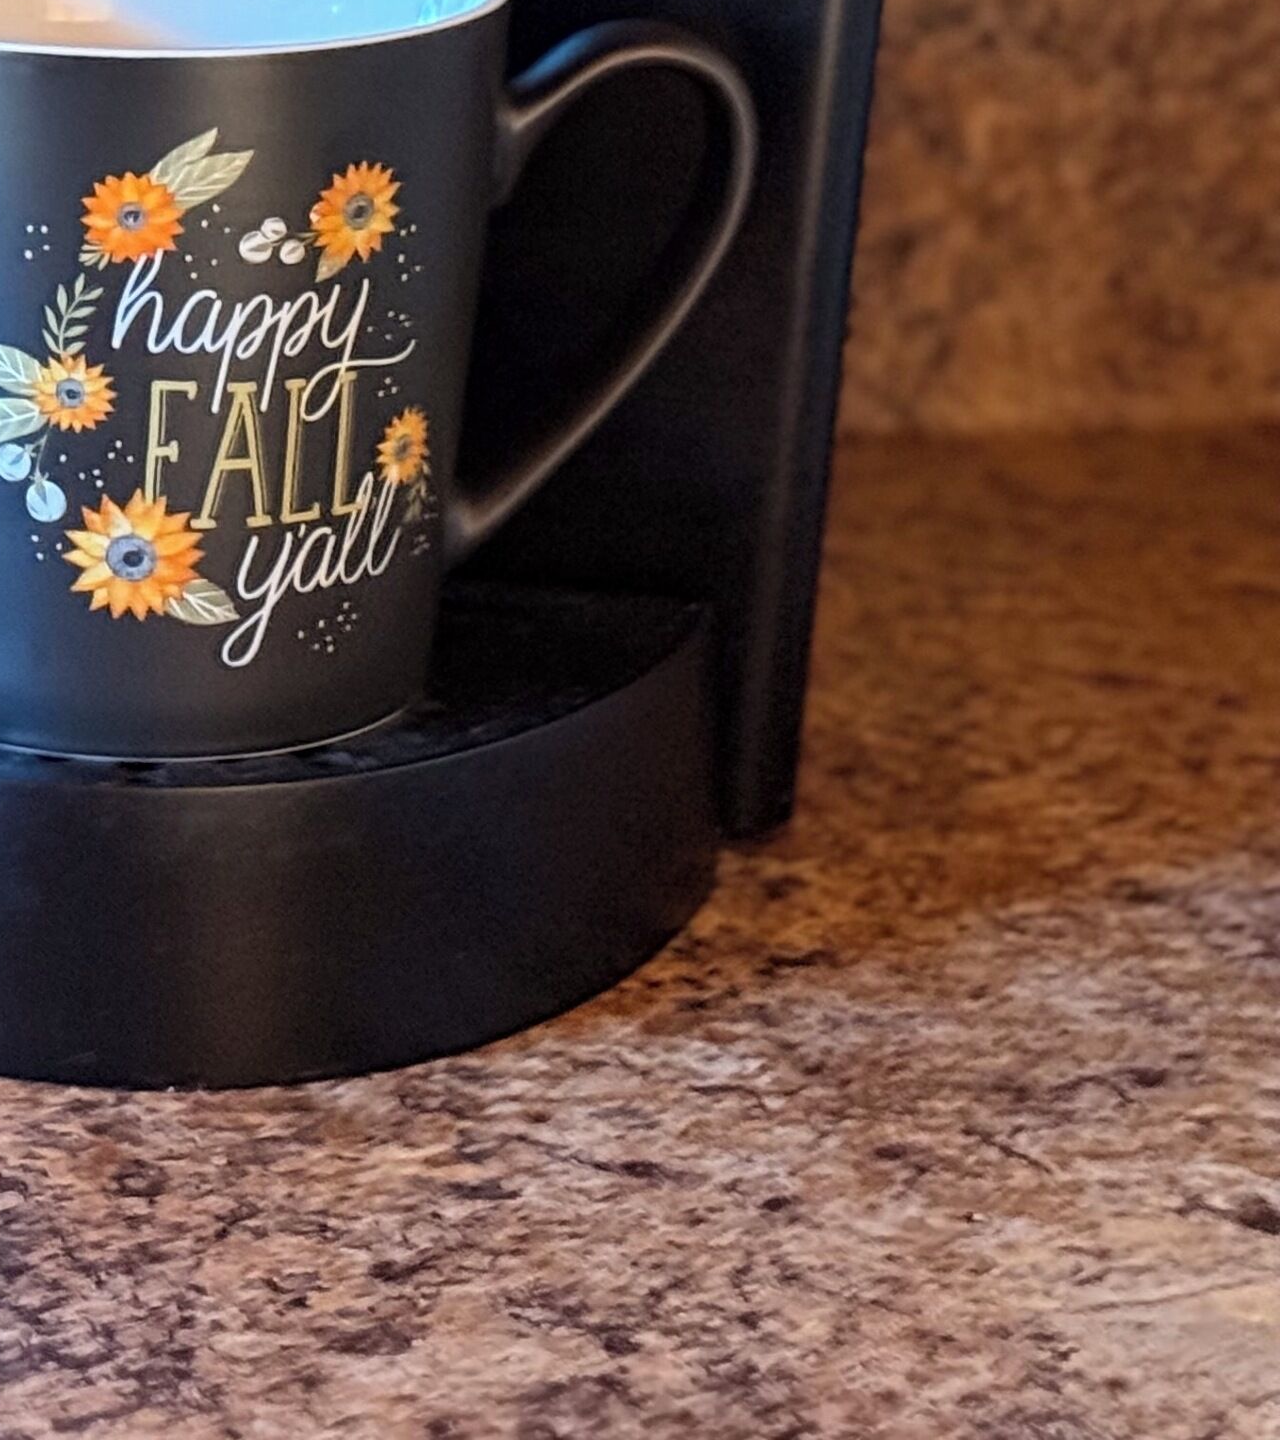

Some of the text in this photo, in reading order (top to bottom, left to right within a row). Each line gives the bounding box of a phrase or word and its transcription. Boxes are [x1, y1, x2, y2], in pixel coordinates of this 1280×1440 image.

[111, 249, 416, 422] happy
[145, 372, 363, 530] FALL
[221, 471, 402, 667] y'all
